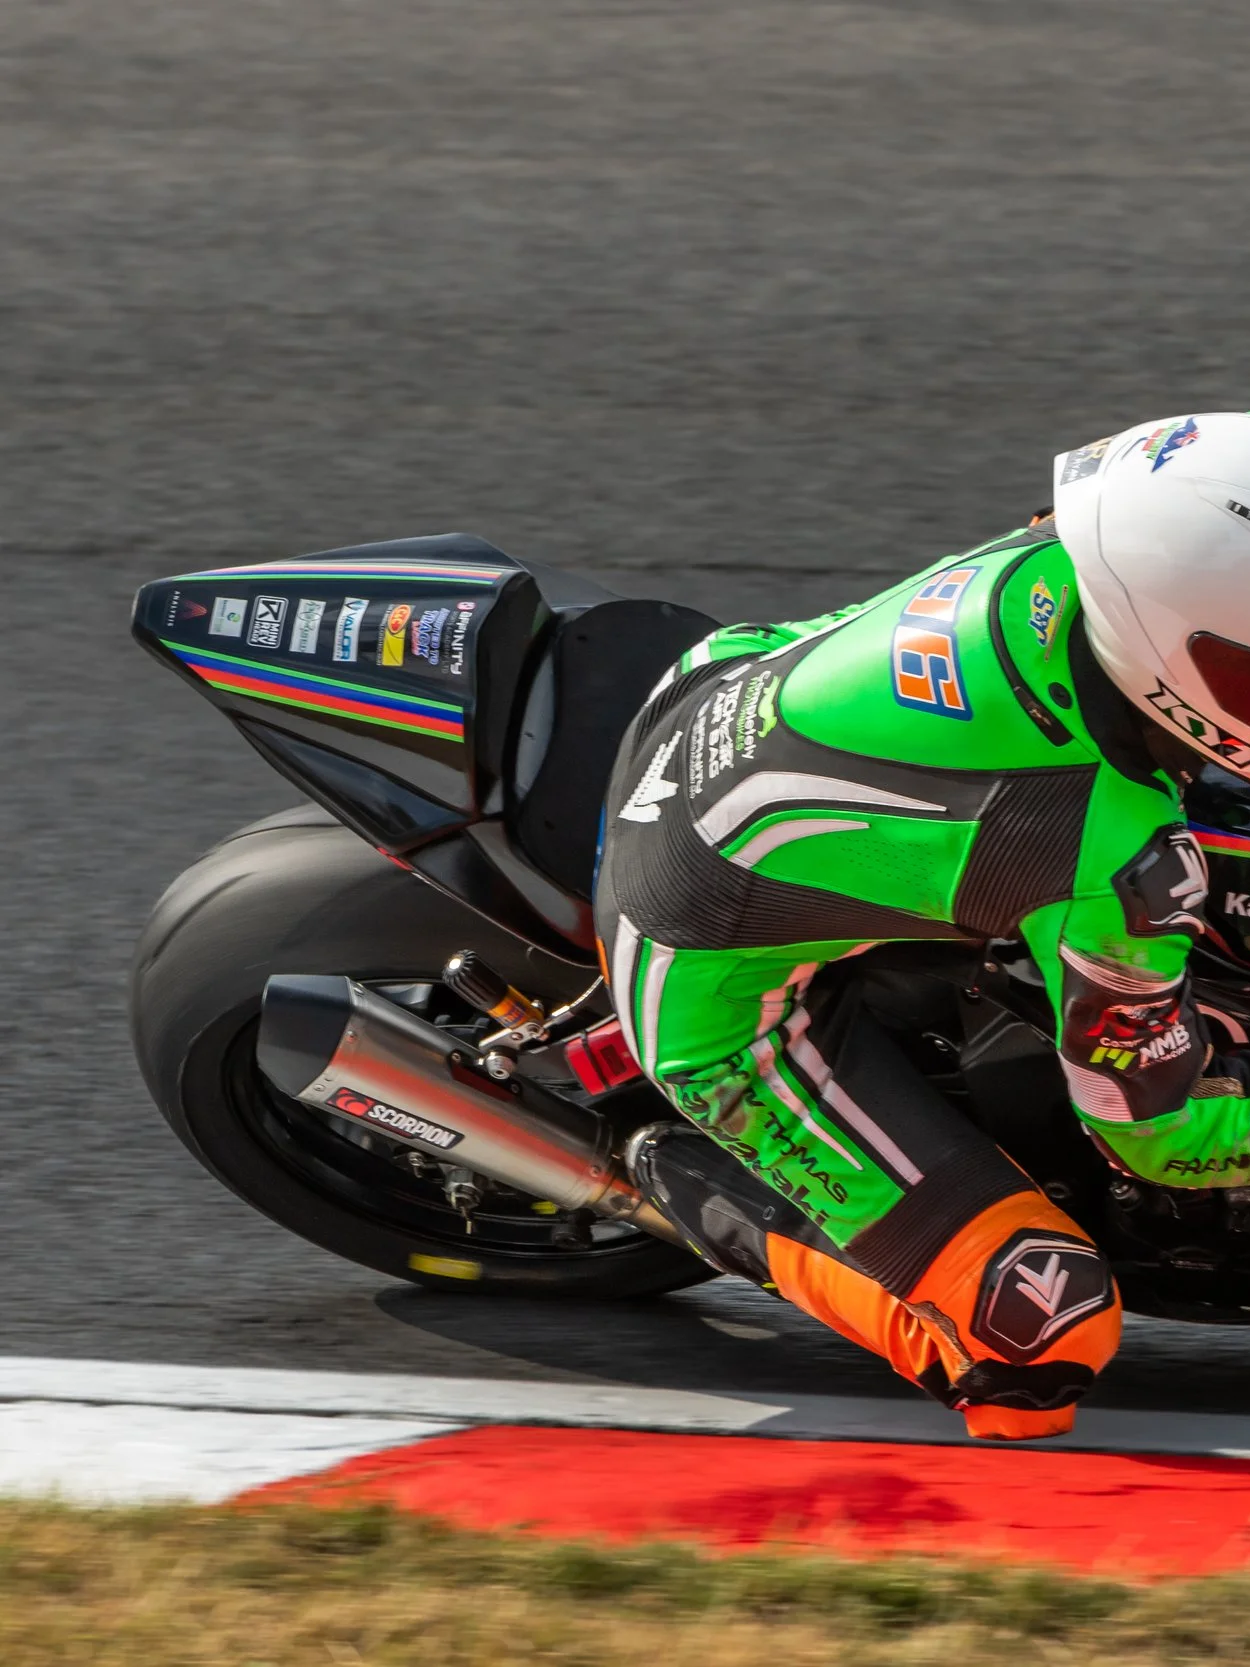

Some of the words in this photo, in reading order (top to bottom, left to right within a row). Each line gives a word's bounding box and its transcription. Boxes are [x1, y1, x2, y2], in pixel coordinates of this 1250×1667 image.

[167, 590, 181, 627] ANALYSIS
[258, 621, 271, 644] REV
[1026, 589, 1057, 647] J&S
[268, 623, 280, 645] MINI
[892, 566, 981, 721] 96
[742, 670, 772, 759] Completely
[708, 729, 720, 779] BAG
[366, 1103, 454, 1150] SCORPION
